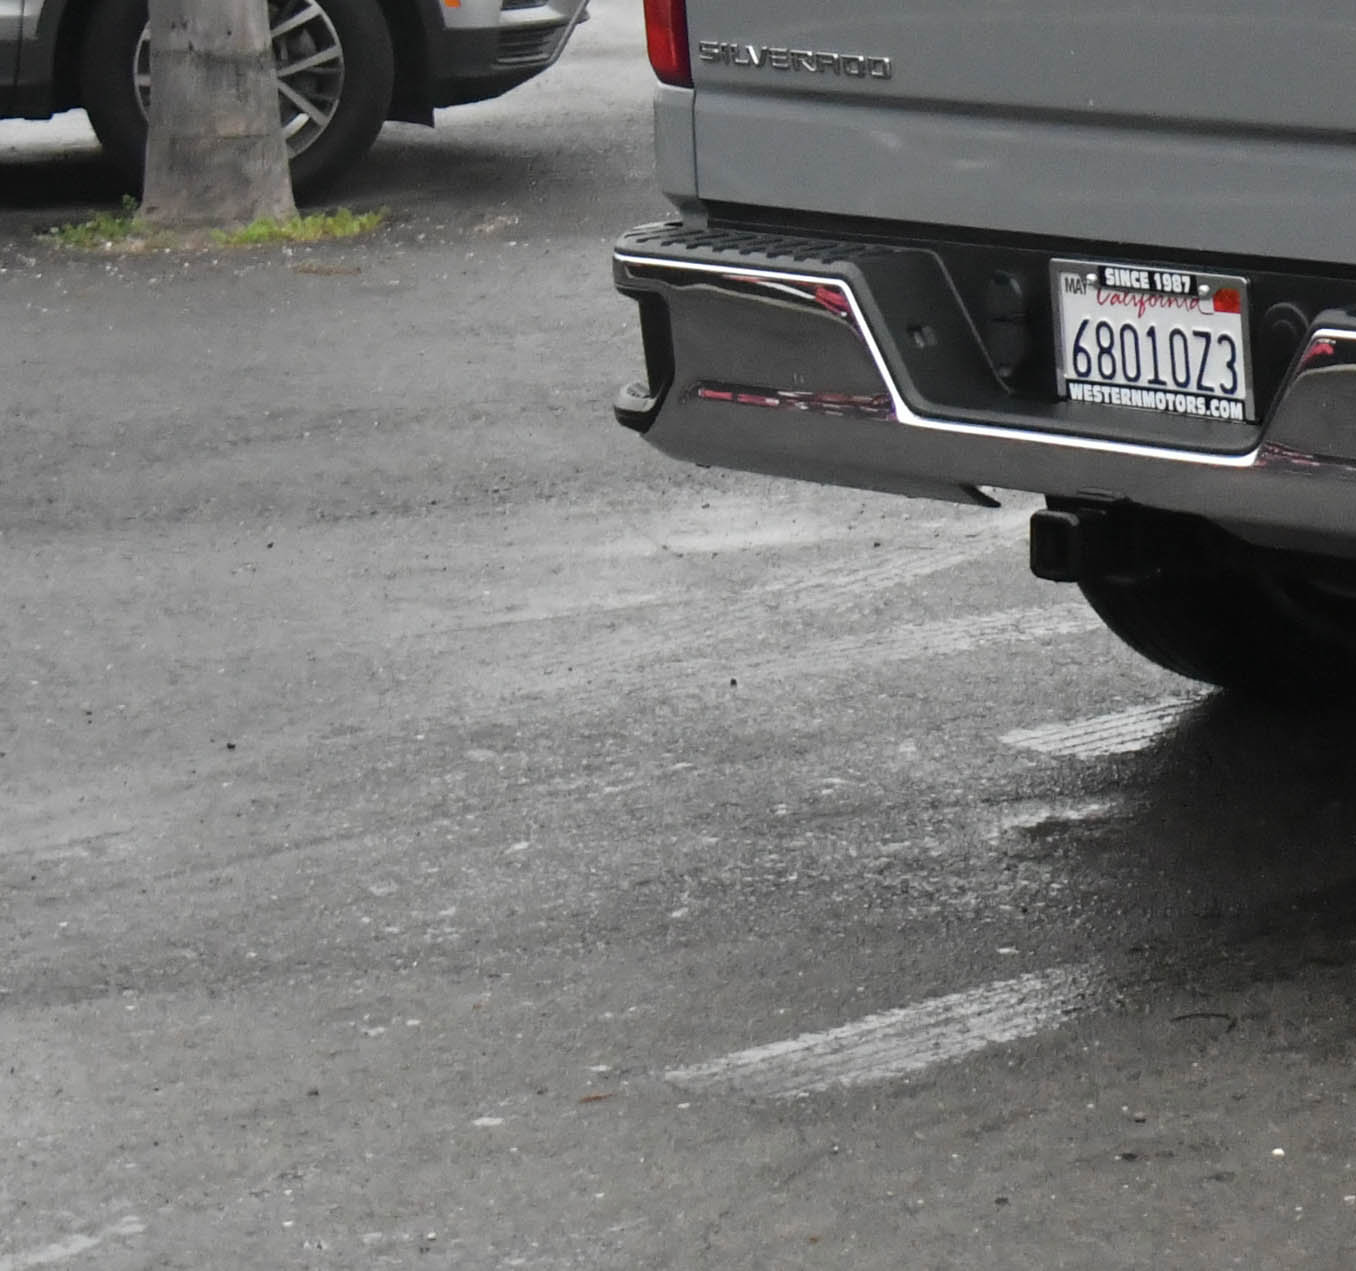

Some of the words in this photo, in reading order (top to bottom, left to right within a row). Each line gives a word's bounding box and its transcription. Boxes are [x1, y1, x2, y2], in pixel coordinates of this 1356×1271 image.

[699, 40, 893, 79] SILVERADO
[1064, 277, 1087, 295] MAY
[1104, 267, 1150, 290] SINCE
[1153, 272, 1191, 294] 1987
[1068, 382, 1244, 420] WESTERNMOTORS.COM
